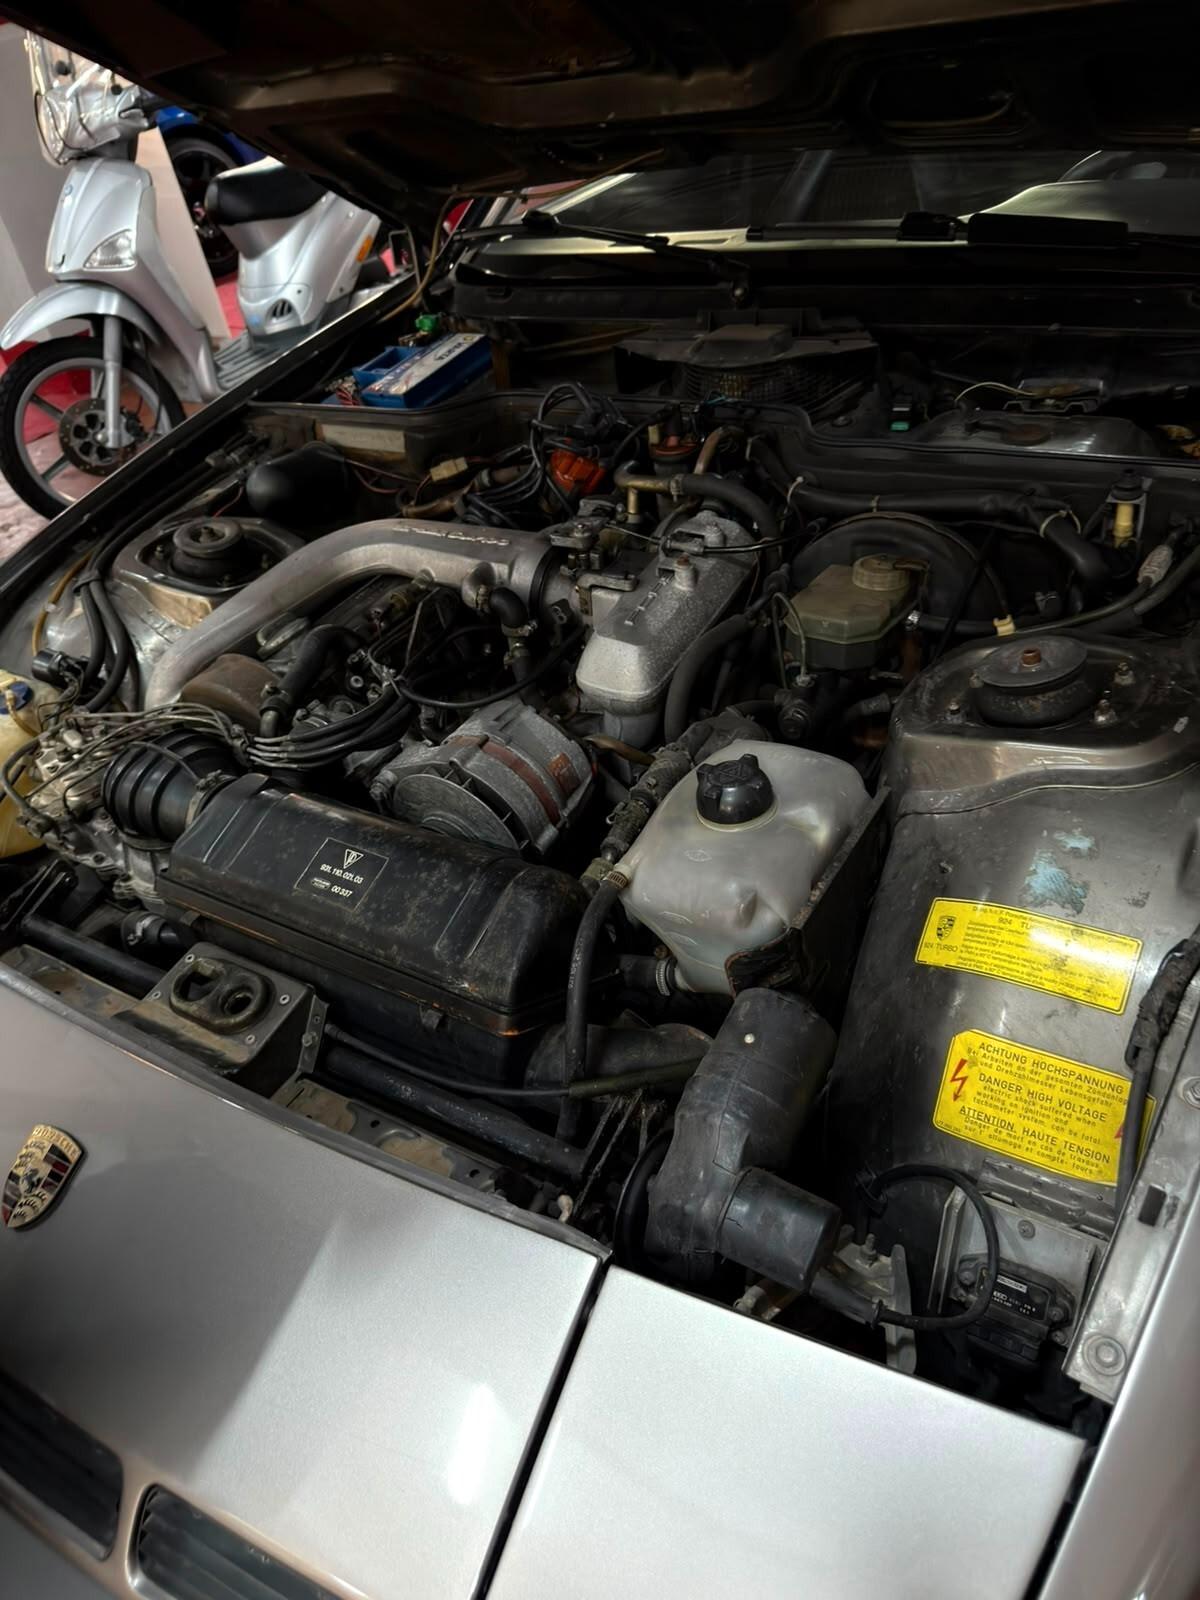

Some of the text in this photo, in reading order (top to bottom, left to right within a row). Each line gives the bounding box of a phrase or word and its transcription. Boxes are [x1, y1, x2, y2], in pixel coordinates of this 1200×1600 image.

[979, 1042, 1123, 1094] ACHTUNG HOCHSPANNUNG
[980, 1060, 993, 1069] und
[996, 1065, 1055, 1088] Drehzahlmesser
[982, 1052, 1012, 1066] Arbeiten
[1030, 1068, 1042, 1077] der
[1045, 1073, 1082, 1089] gesamten
[973, 1097, 1013, 1115] tachometer
[1051, 1124, 1065, 1133] can
[976, 1090, 1005, 1104] working
[1021, 1105, 1050, 1120] ignition
[1055, 1117, 1069, 1126] and
[978, 1072, 1107, 1121] DANGER HIGH VOLTAGE
[983, 1085, 1096, 1126] electric shock suffered when
[964, 1117, 989, 1130] Danger
[1006, 1131, 1023, 1141] mort
[1040, 1144, 1053, 1153] cas
[1070, 1154, 1098, 1167] travaux
[988, 1133, 1020, 1149] allumage
[1022, 1126, 1057, 1145] HAUTE
[1062, 1140, 1110, 1163] TENSION
